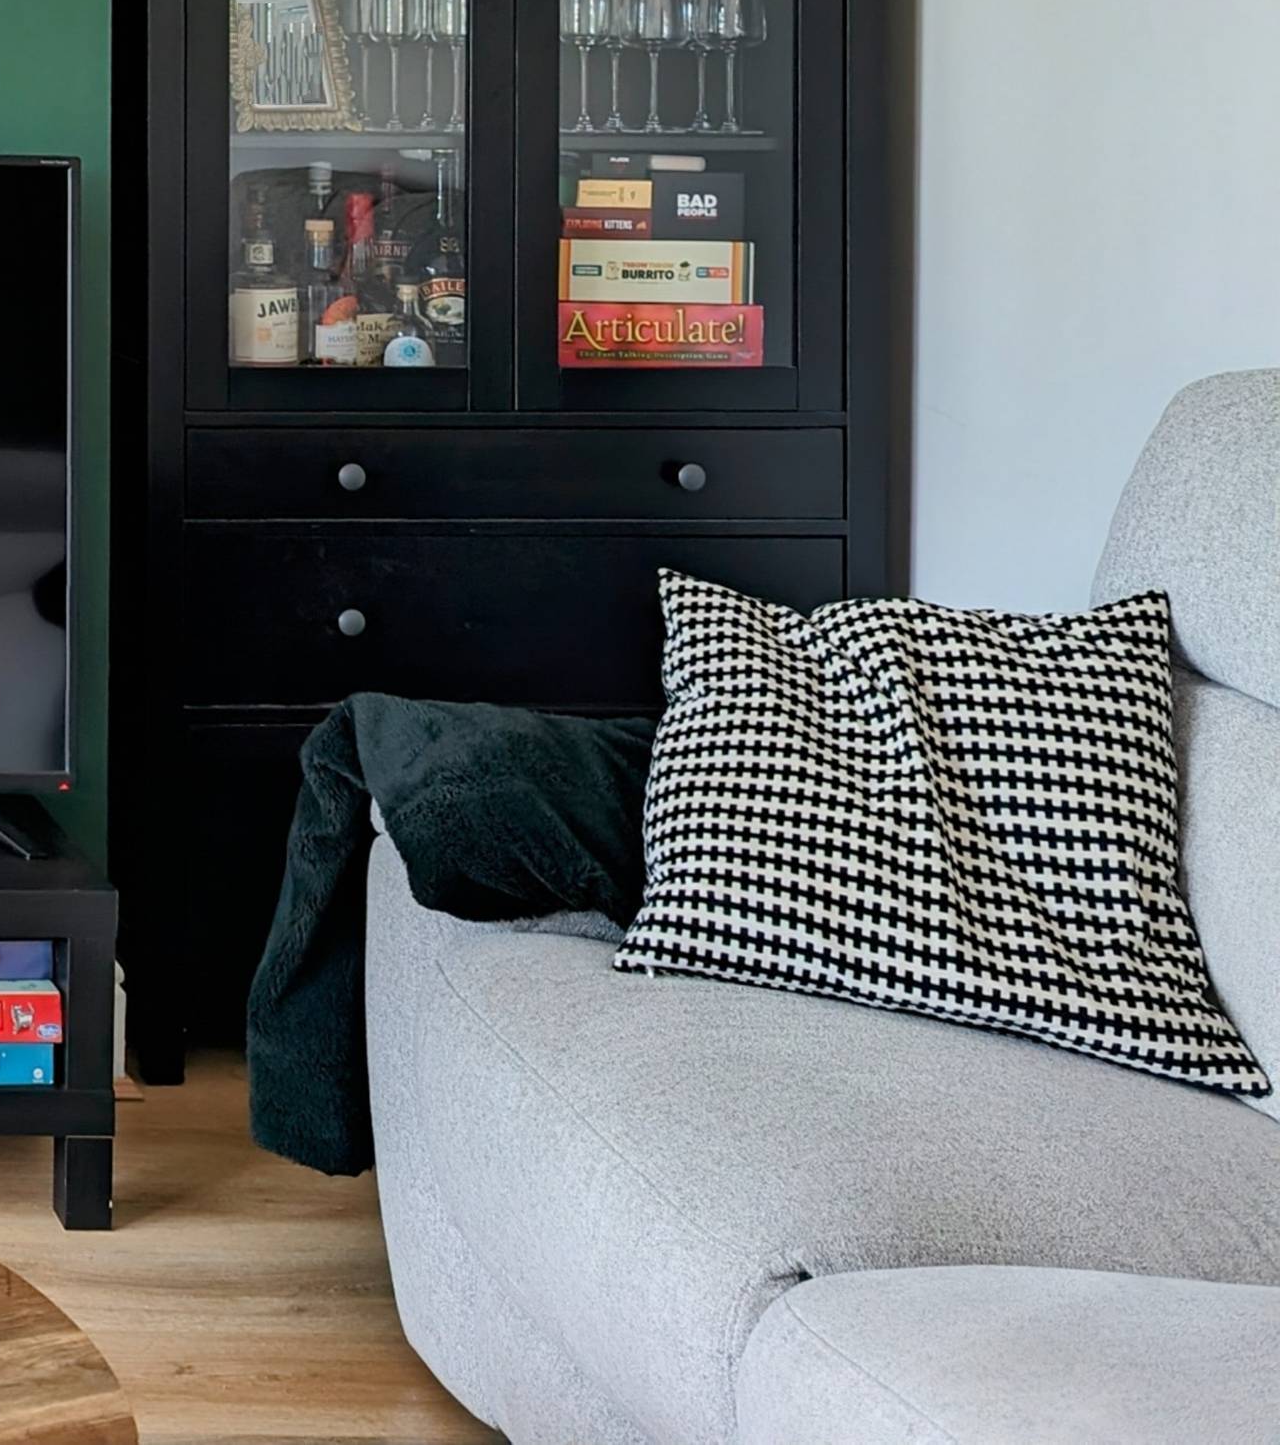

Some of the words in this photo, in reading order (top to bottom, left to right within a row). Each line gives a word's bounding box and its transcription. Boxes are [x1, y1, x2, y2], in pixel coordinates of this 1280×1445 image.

[677, 193, 717, 209] BAD
[677, 208, 718, 217] PEOPLE
[603, 219, 633, 230] KITTENS
[621, 269, 675, 281] BURRITO
[562, 309, 744, 351] Articulate!
[618, 351, 651, 360] Talking
